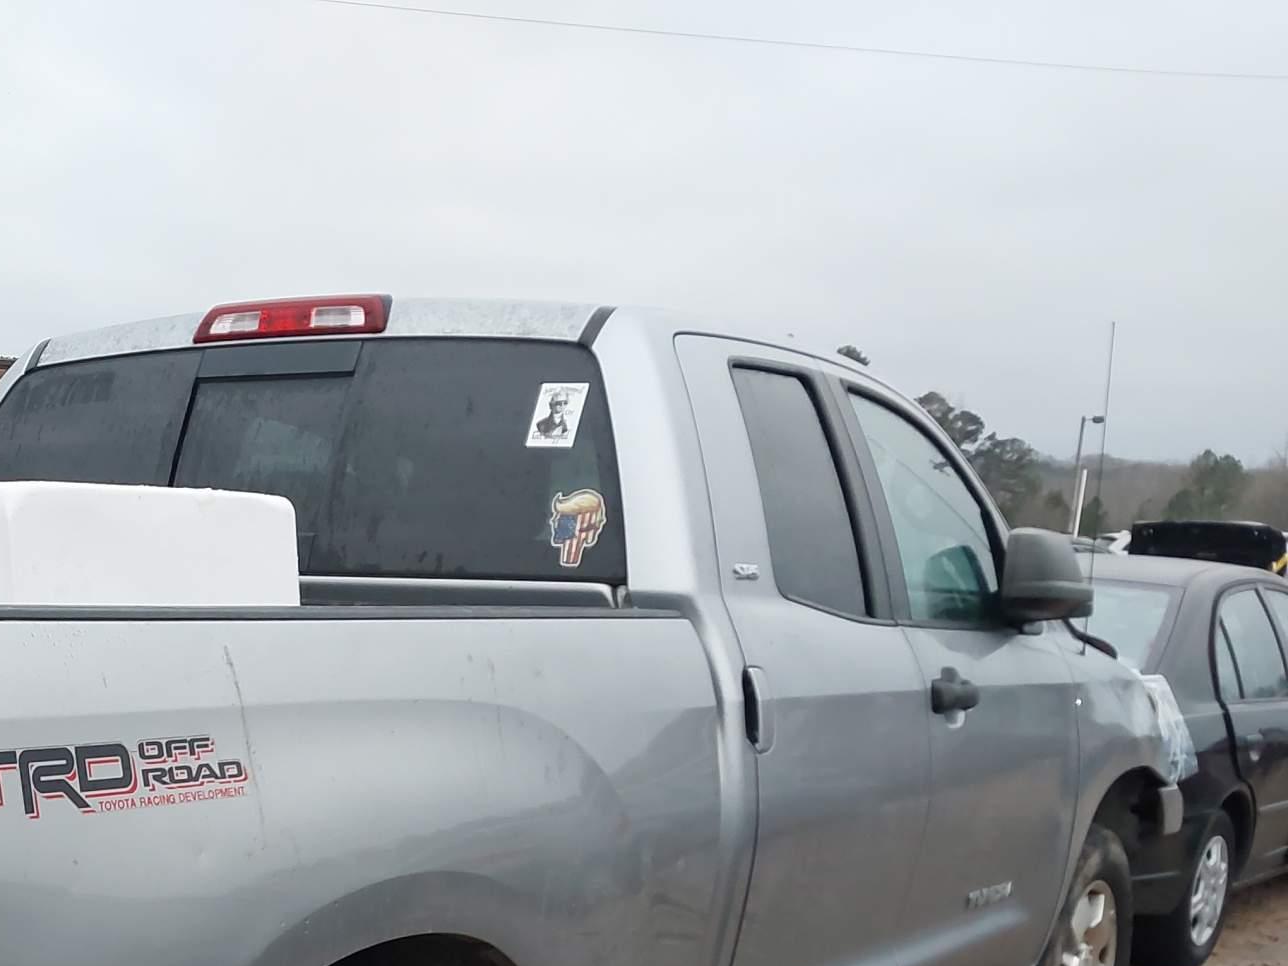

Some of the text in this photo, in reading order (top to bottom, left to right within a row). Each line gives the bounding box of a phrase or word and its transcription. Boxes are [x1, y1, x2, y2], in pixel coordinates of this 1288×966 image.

[137, 737, 215, 764] OFF
[142, 760, 248, 791] ROAD
[98, 785, 246, 812] TOYOTA RACING DEVELOPMENT
